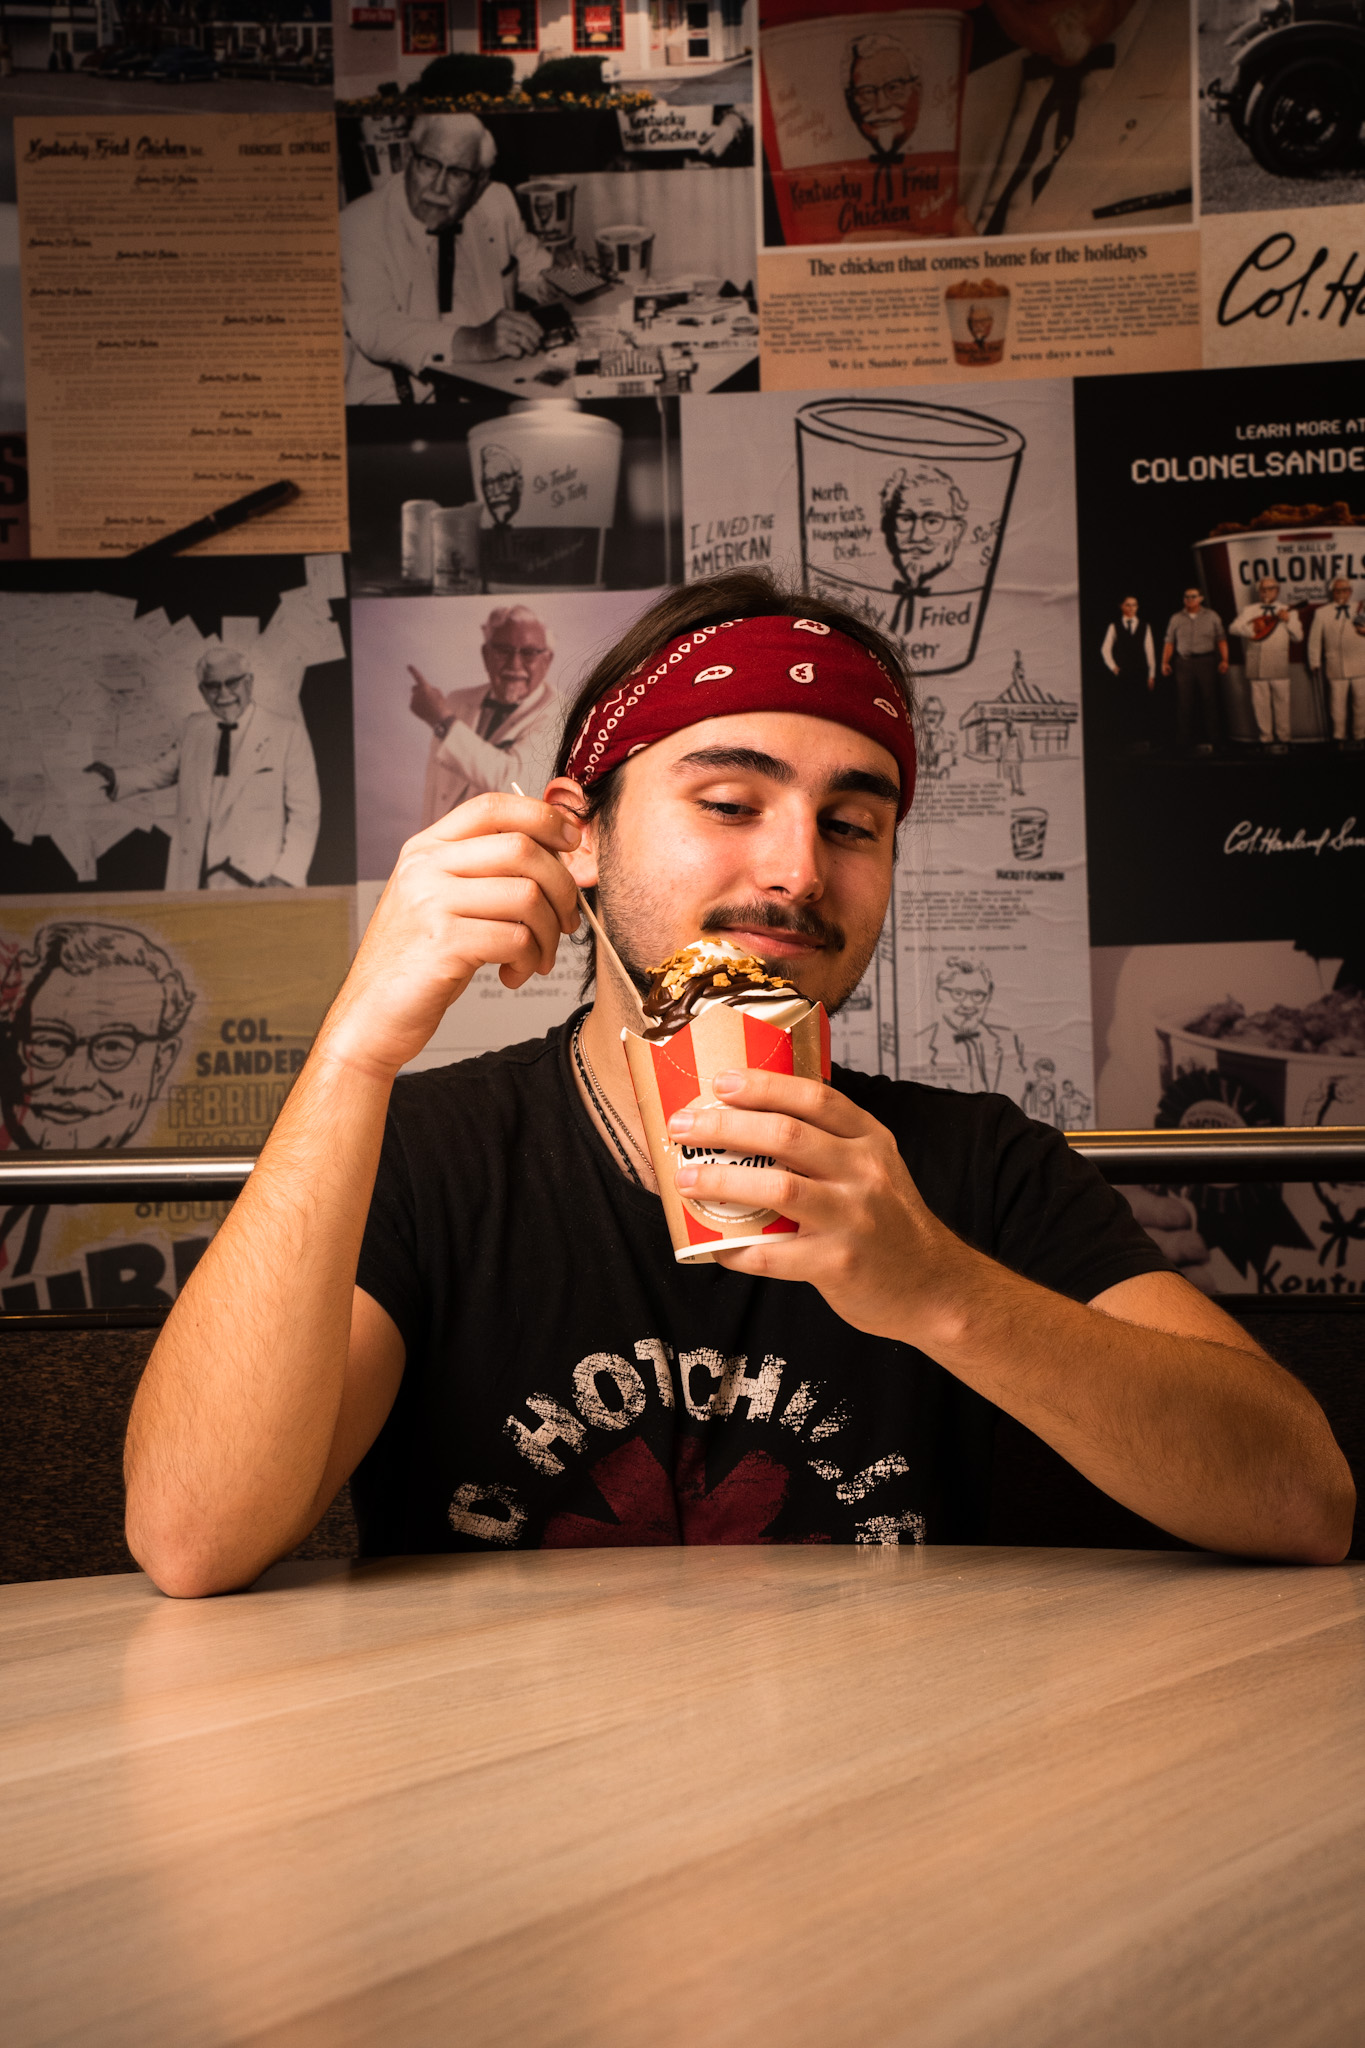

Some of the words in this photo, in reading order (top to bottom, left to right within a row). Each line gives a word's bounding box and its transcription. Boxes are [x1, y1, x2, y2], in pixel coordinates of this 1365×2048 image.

[790, 175, 862, 211] Kentucky
[902, 167, 940, 198] Fried
[838, 201, 910, 233] Chicken
[808, 258, 836, 276] The
[840, 254, 895, 275] chicken
[898, 253, 927, 272] that
[931, 255, 979, 270] comes
[984, 250, 1026, 268] home
[1030, 247, 1052, 265] for
[1055, 246, 1080, 264] the
[1084, 243, 1148, 263] holidays
[1216, 232, 1329, 328] Col.
[868, 356, 908, 370] Sunday
[912, 354, 949, 367] dinner
[1011, 352, 1042, 362] seven
[1046, 348, 1071, 362] days
[1085, 346, 1116, 358] week
[1235, 421, 1291, 441] LEARN
[1295, 418, 1342, 438] MORE
[811, 481, 848, 502] North
[806, 505, 866, 524] America's
[689, 524, 700, 550] I
[705, 516, 750, 545] LIVED
[752, 514, 775, 532] THE
[690, 535, 772, 580] AMERICAN
[919, 602, 973, 630] Fried
[221, 1018, 283, 1044] COL.
